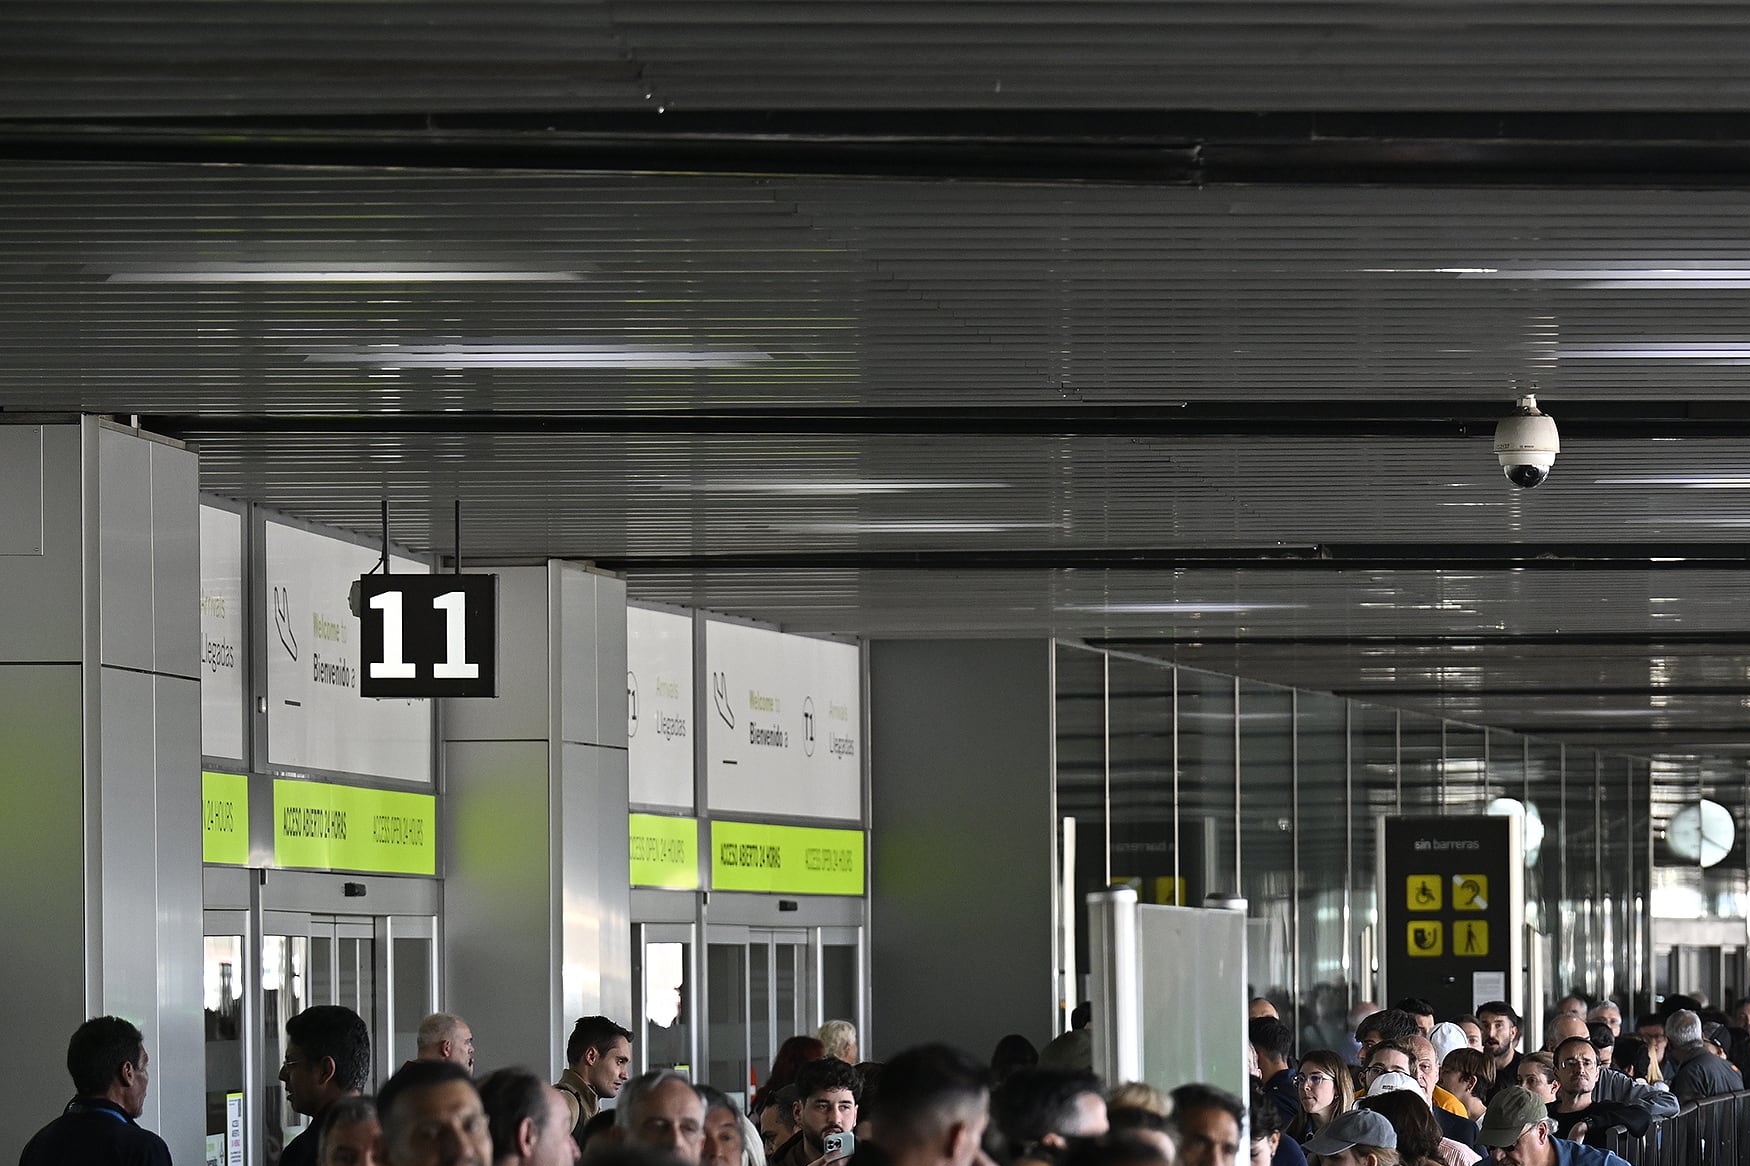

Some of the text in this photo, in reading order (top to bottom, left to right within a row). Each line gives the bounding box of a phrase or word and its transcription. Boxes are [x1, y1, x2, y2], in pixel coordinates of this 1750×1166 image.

[312, 611, 340, 642] Welcome
[370, 591, 479, 679] 11
[313, 652, 356, 688] Bienvenido a
[749, 688, 774, 712] Welcome
[656, 709, 687, 741] Llegadas
[749, 720, 783, 747] Bienvenido
[803, 711, 814, 741] T1
[829, 732, 855, 760] Llegadas
[283, 807, 347, 841] ACCESO ABIERTO 24 HORAS
[372, 815, 390, 844] ACCESS
[720, 843, 738, 867] ACCESO
[1414, 839, 1480, 850] sin barreras
